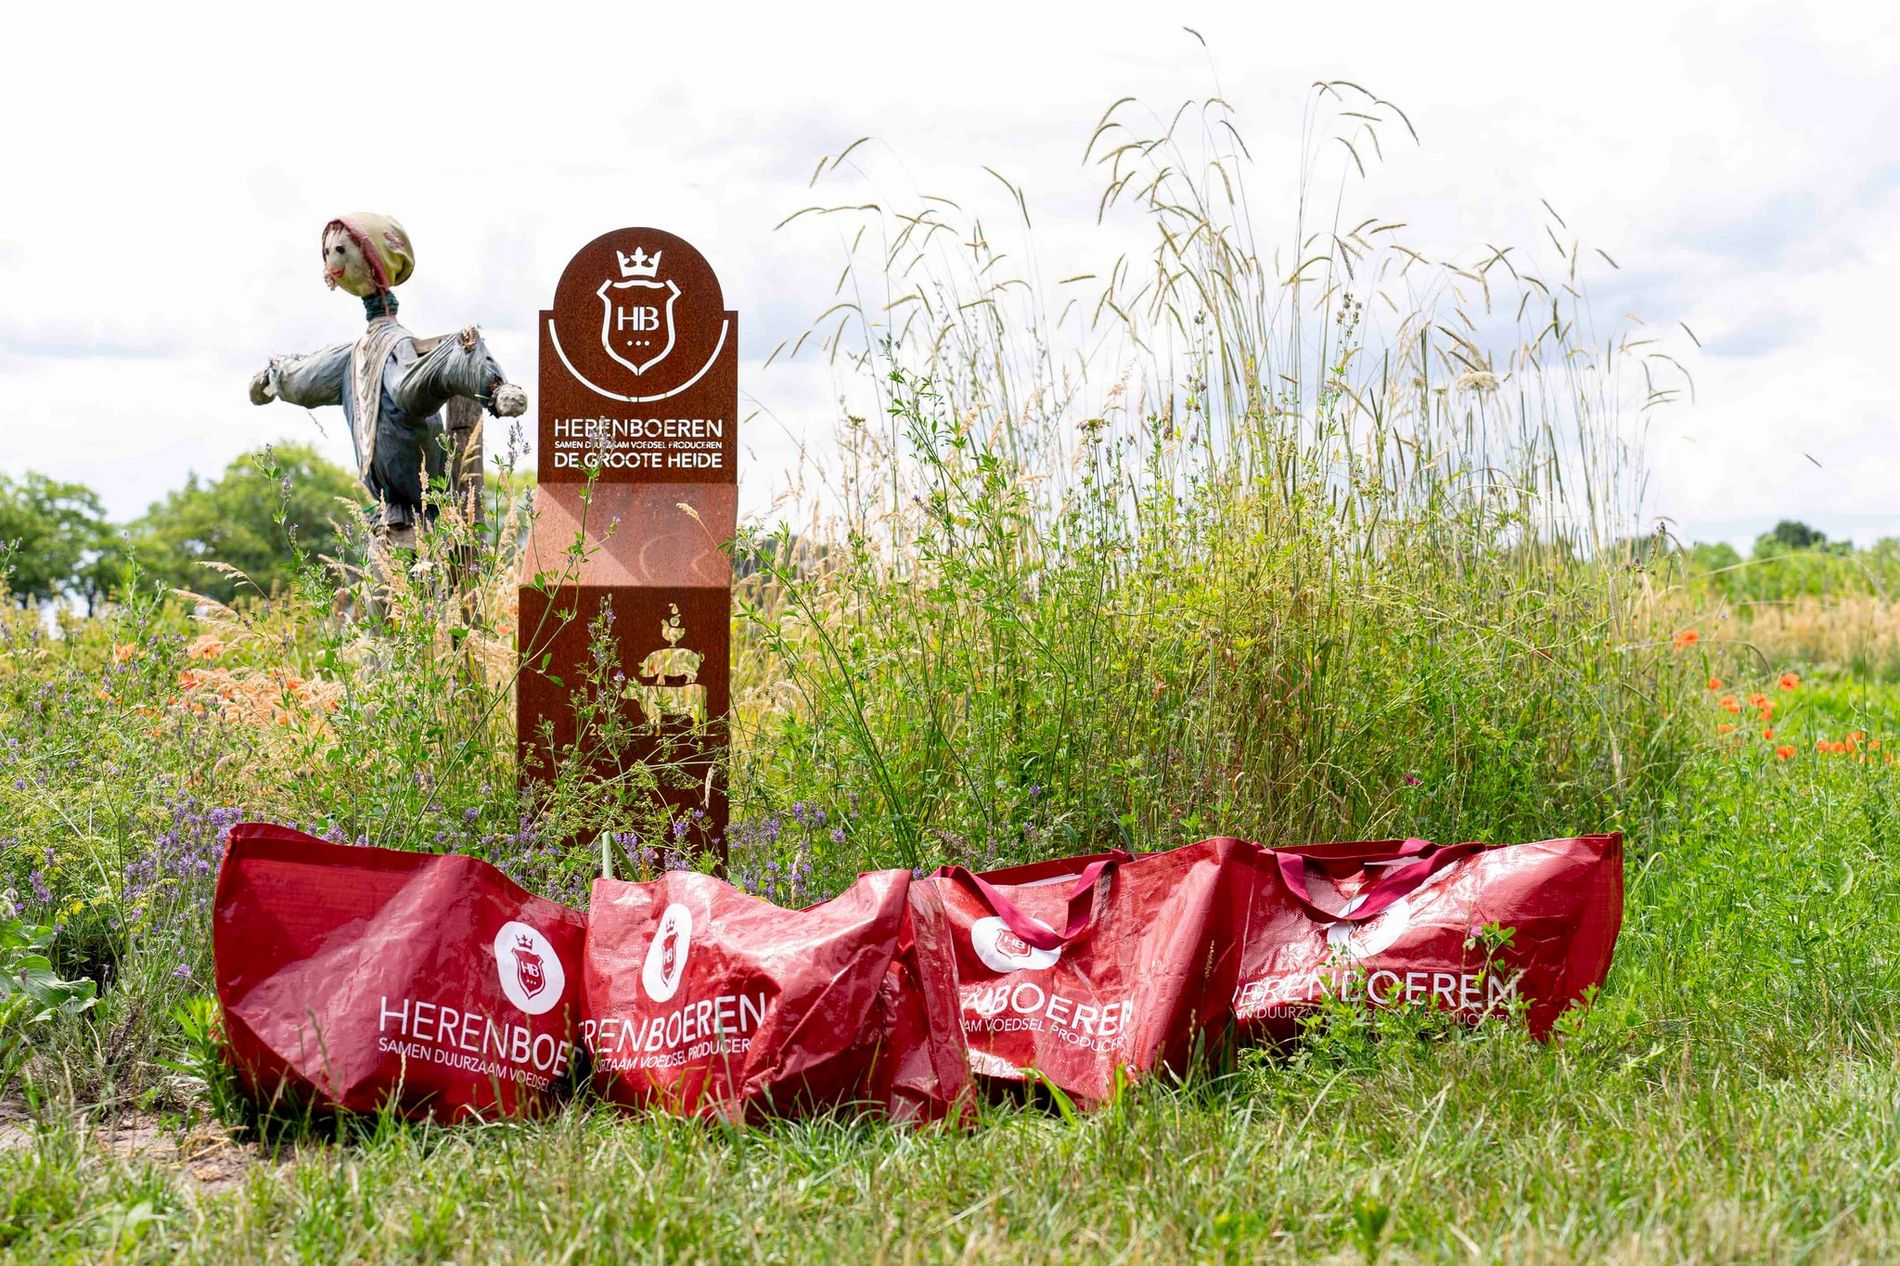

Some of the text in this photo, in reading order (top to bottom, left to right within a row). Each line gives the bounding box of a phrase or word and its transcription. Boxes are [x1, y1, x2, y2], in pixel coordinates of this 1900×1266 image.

[617, 306, 660, 331] HB
[554, 418, 723, 438] HERENBOEREN
[554, 441, 584, 450] SAMEN
[631, 441, 667, 450] VOEDSEL
[669, 441, 723, 450] PRODUCEREN
[554, 452, 723, 468] DE GROOTE HEIDE
[1003, 935, 1026, 950] HB
[520, 960, 540, 978] HB
[984, 1018, 1046, 1033] VOEDSEL
[378, 1037, 432, 1061] SAMEN
[434, 1049, 507, 1079] DUURZAAM
[509, 1067, 551, 1093] VOEDSEL
[640, 1052, 687, 1069] VOEDSEL
